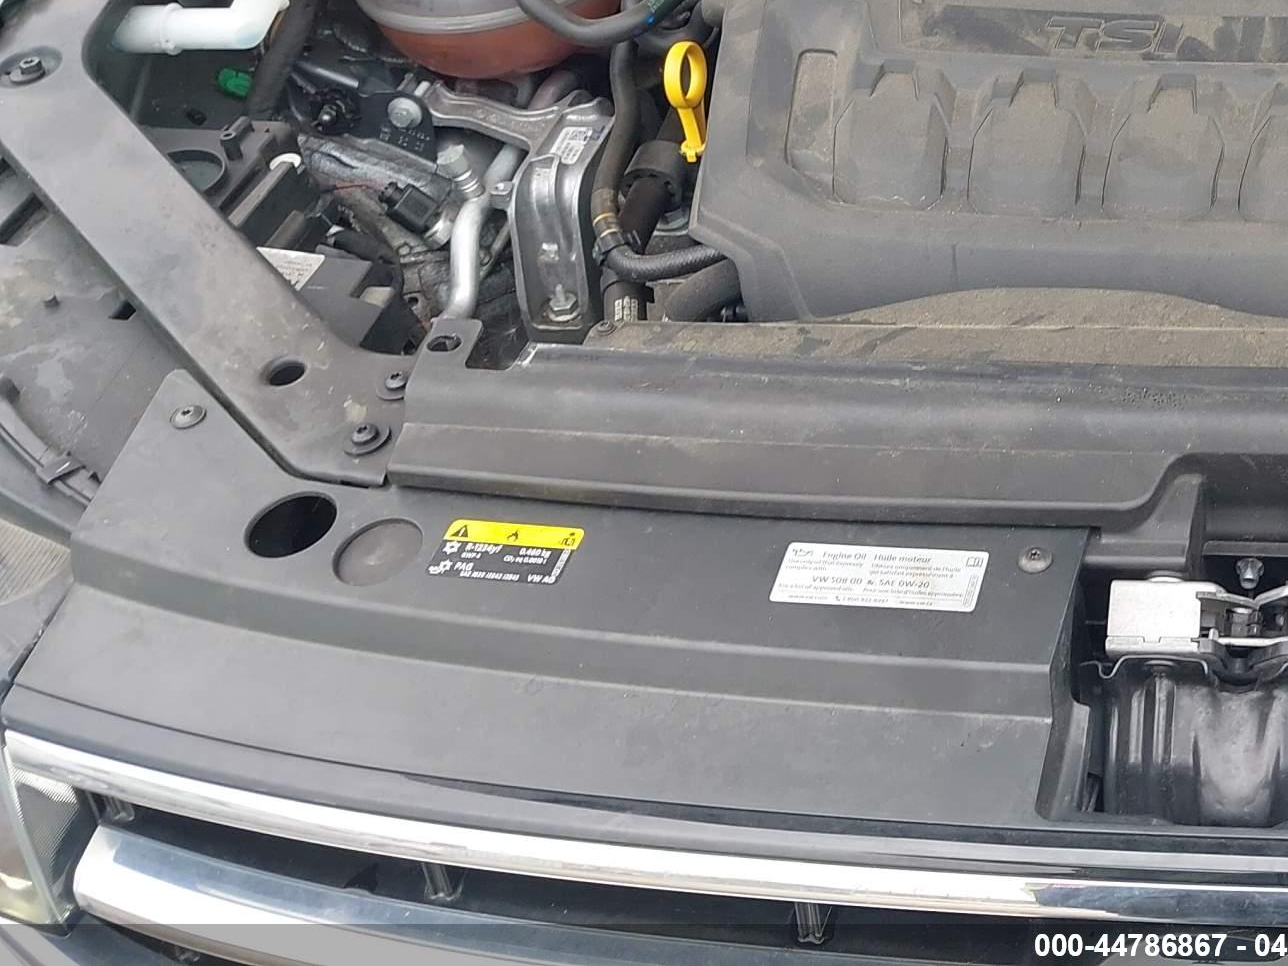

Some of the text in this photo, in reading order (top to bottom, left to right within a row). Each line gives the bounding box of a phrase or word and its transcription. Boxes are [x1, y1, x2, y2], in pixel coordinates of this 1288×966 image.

[1046, 16, 1184, 54] TSI
[822, 551, 931, 564] Engine Oil Huile moteur
[454, 561, 474, 571] PAG
[527, 574, 541, 582] VW
[812, 575, 829, 583] VW
